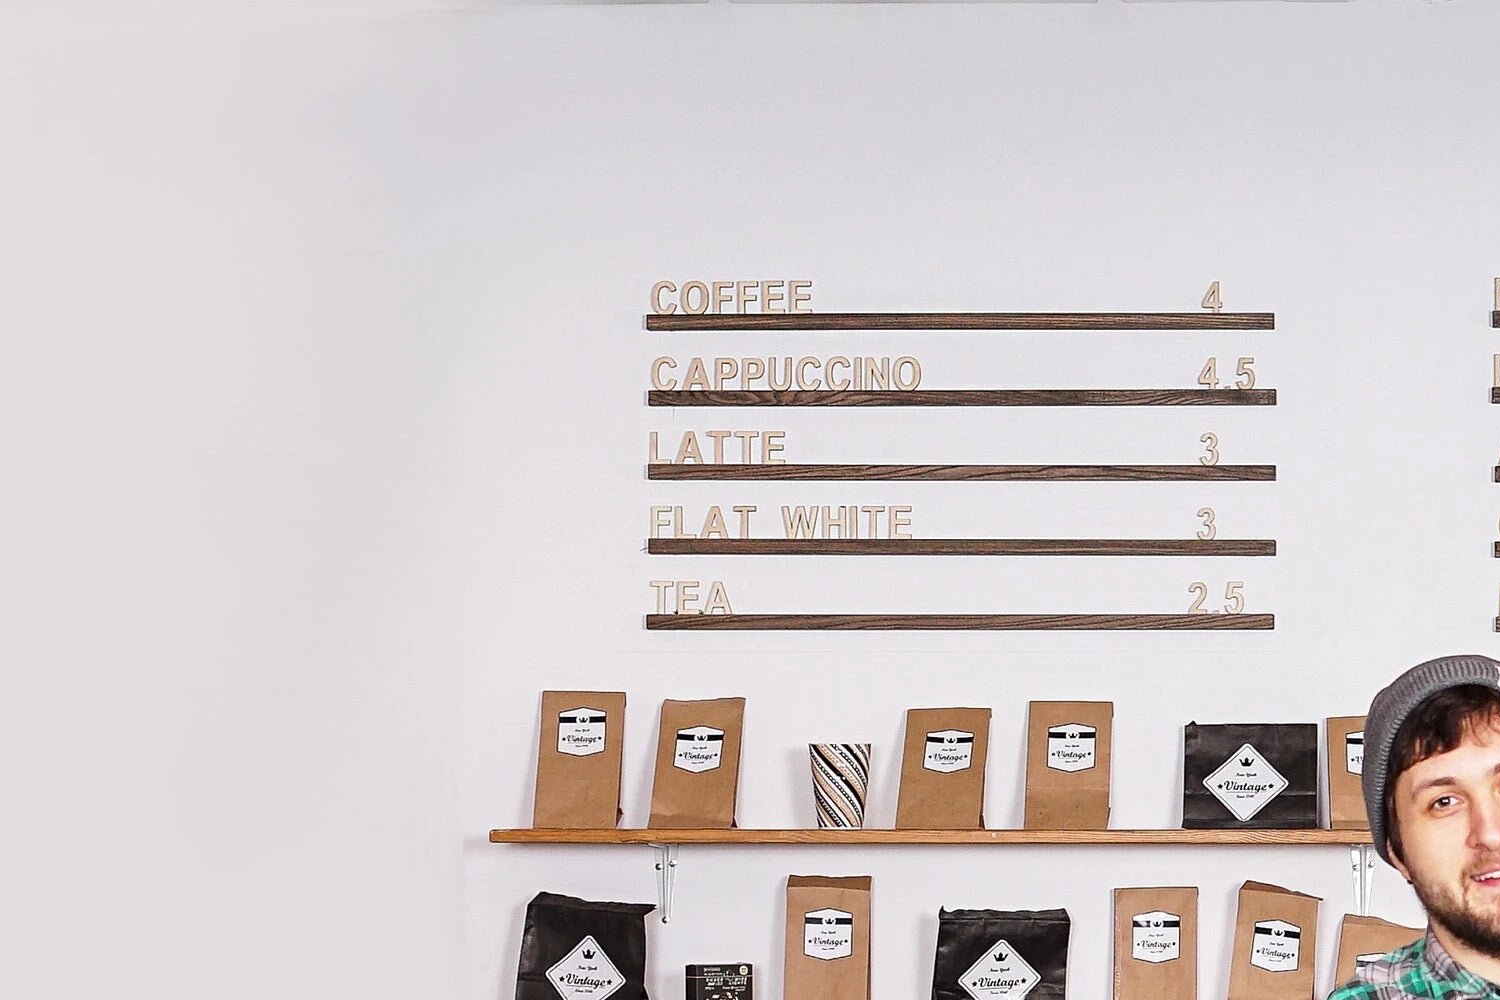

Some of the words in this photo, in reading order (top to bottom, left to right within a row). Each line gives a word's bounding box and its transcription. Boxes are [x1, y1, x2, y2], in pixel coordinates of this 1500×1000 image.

[650, 280, 813, 314] COFFEE
[1202, 281, 1222, 313] 4
[651, 355, 922, 390] CAPPUCCINO
[1198, 357, 1256, 390] 4.5
[648, 430, 786, 464] LATTE
[1199, 431, 1220, 465] 3
[649, 505, 756, 539] FLAT
[782, 505, 913, 538] WHITE
[1197, 507, 1217, 540] 3
[649, 580, 733, 614] TEA
[1188, 581, 1245, 614] 2.5
[1223, 780, 1267, 794] Vintage
[565, 973, 606, 989] Vintage
[978, 977, 1019, 990] Vintage
